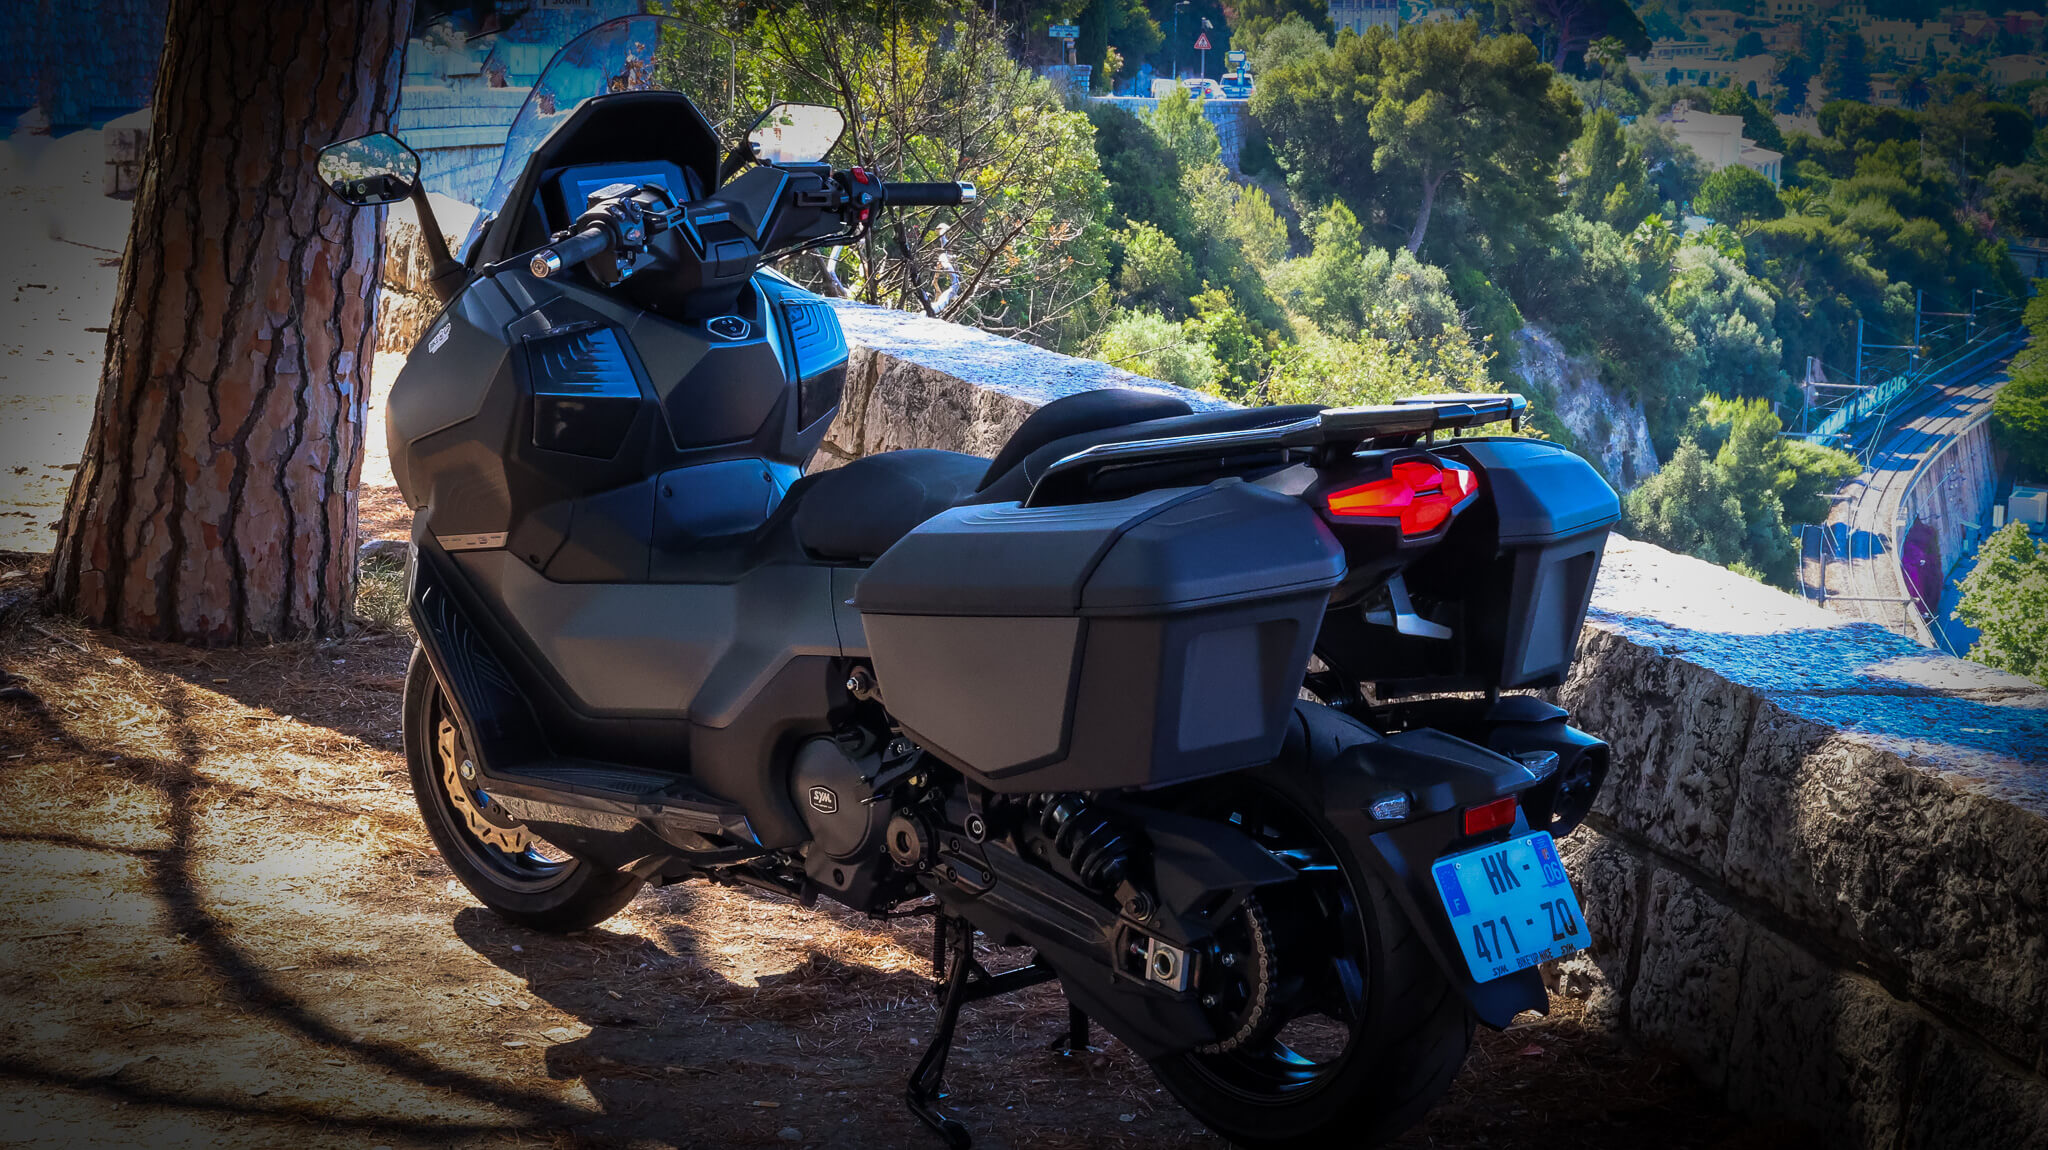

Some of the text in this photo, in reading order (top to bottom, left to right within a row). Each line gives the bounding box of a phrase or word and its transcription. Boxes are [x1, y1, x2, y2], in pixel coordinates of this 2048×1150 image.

[813, 790, 832, 803] SYM
[1481, 849, 1521, 895] HK
[1543, 861, 1562, 883] 06
[1454, 897, 1462, 912] F
[1472, 915, 1520, 963] 471
[1540, 898, 1579, 942] ZQ
